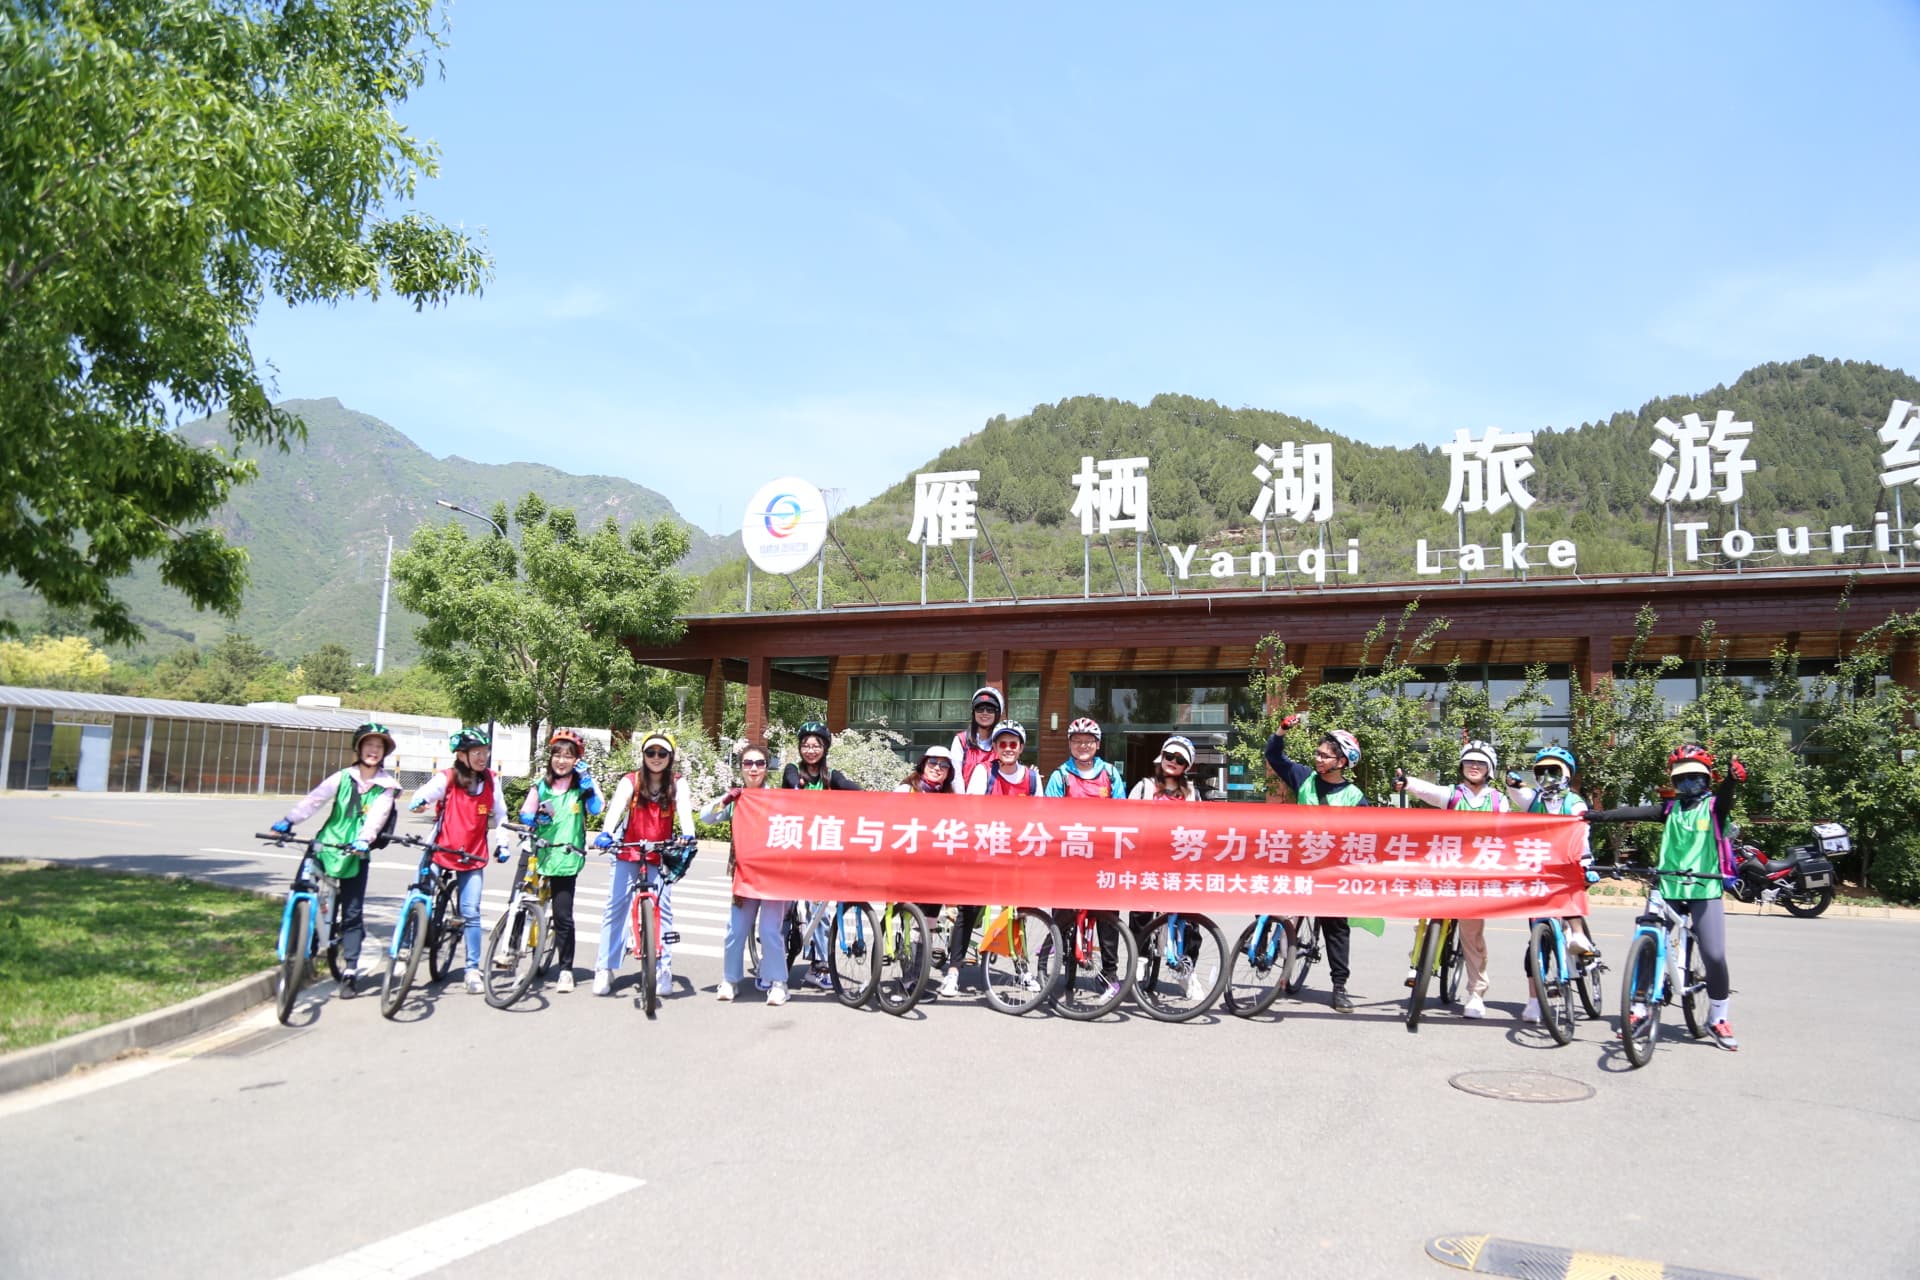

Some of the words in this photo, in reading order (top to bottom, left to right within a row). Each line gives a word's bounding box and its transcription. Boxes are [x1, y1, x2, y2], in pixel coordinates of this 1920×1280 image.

[1167, 538, 1359, 582] Yanqi
[1416, 532, 1577, 575] Lake
[766, 814, 1139, 859] 颜值与才华难分高下
[1170, 825, 1552, 874] 努力培梦想生根发芽
